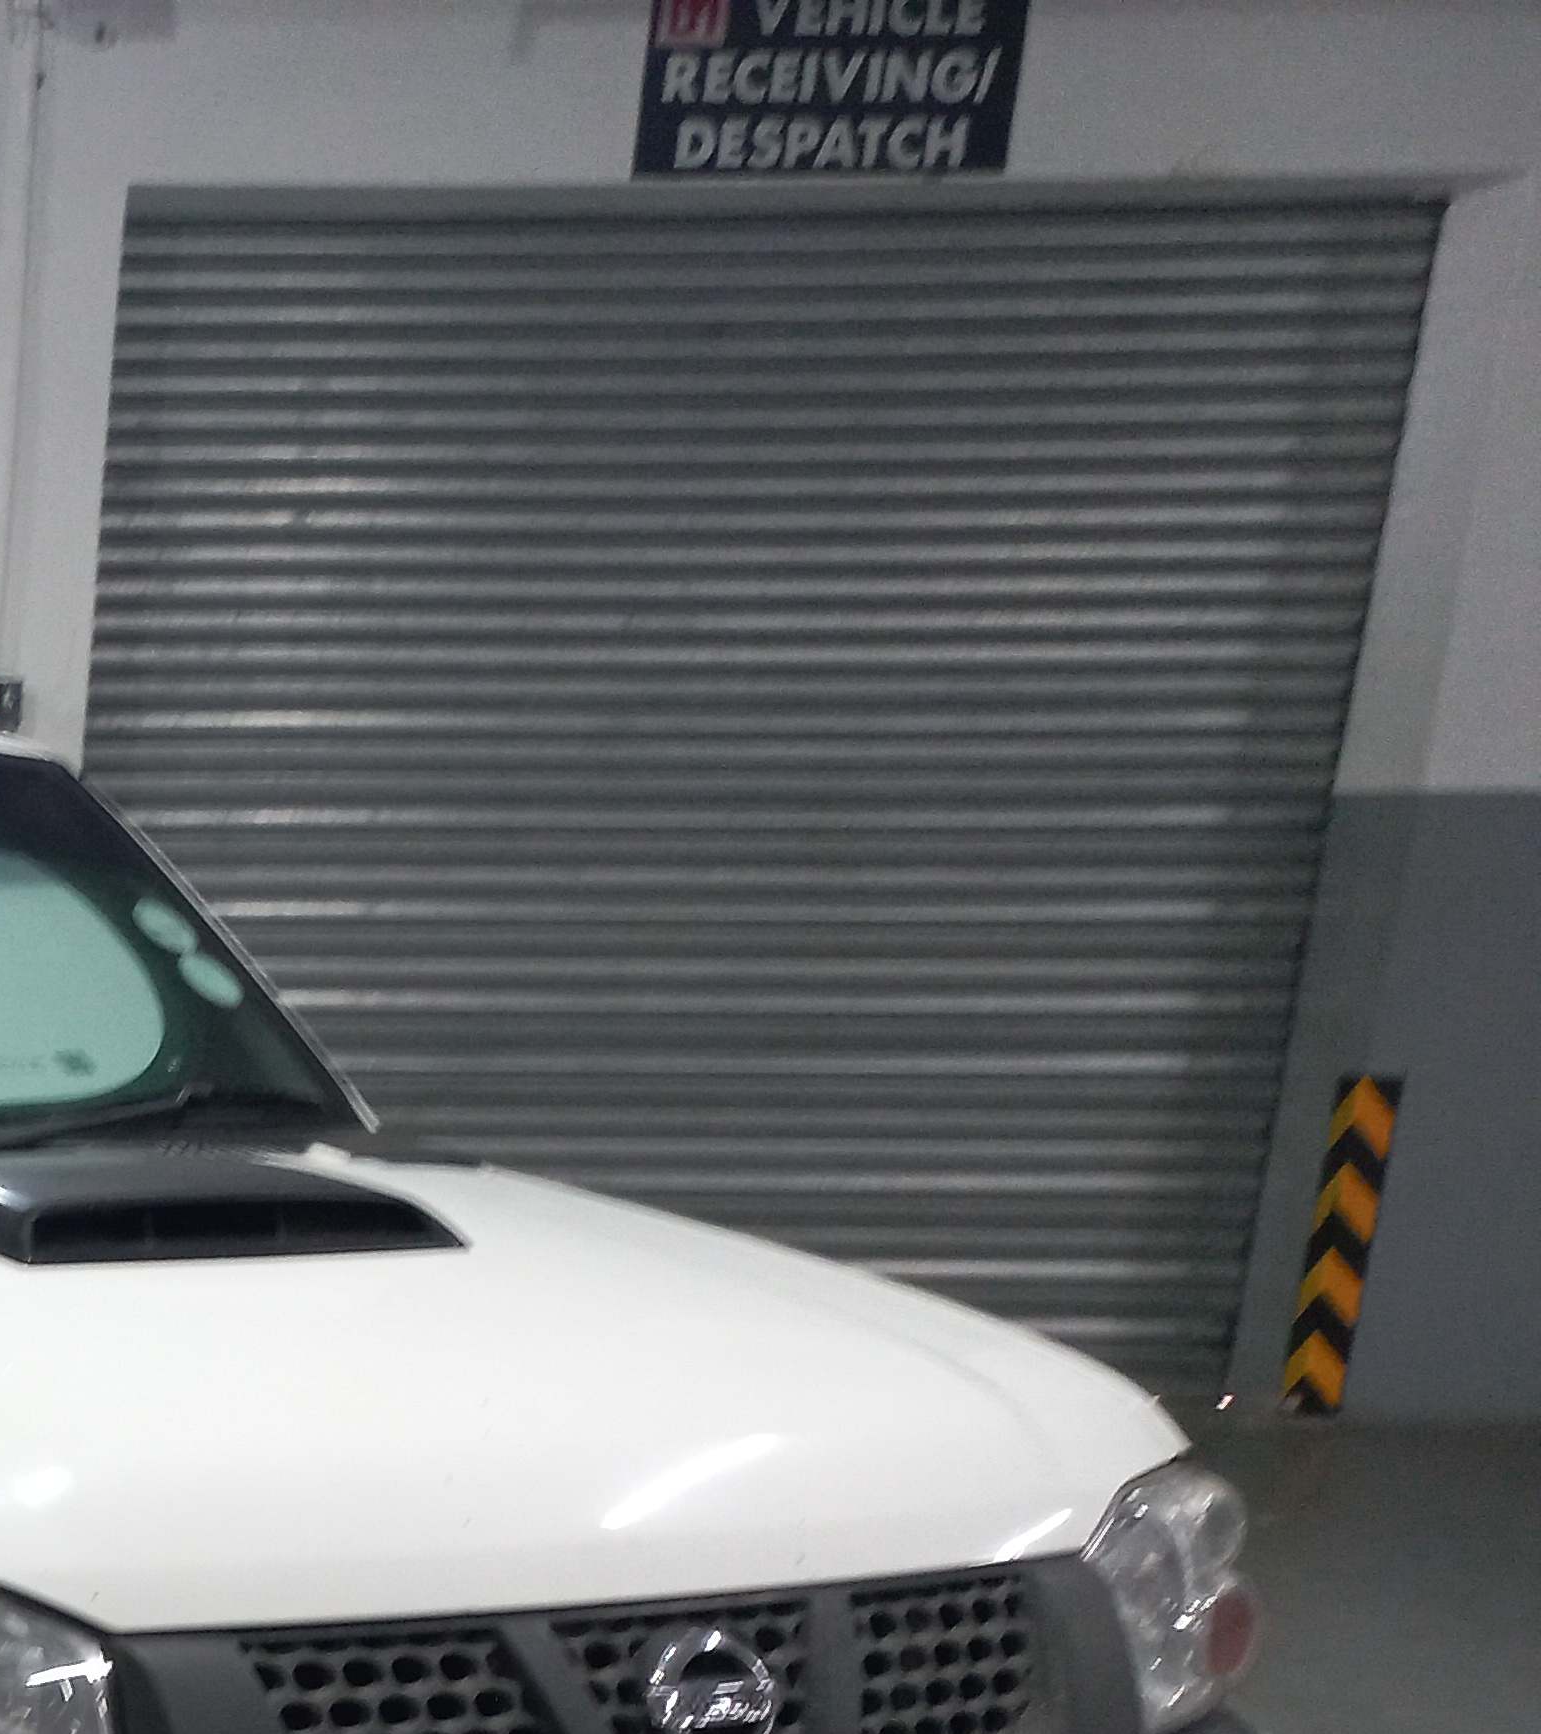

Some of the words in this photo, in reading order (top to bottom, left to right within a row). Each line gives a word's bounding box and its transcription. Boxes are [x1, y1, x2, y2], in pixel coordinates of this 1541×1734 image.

[755, 0, 985, 37] VEHICLE
[661, 45, 1003, 104] RECEIVING/
[673, 114, 971, 170] DESPATCH
